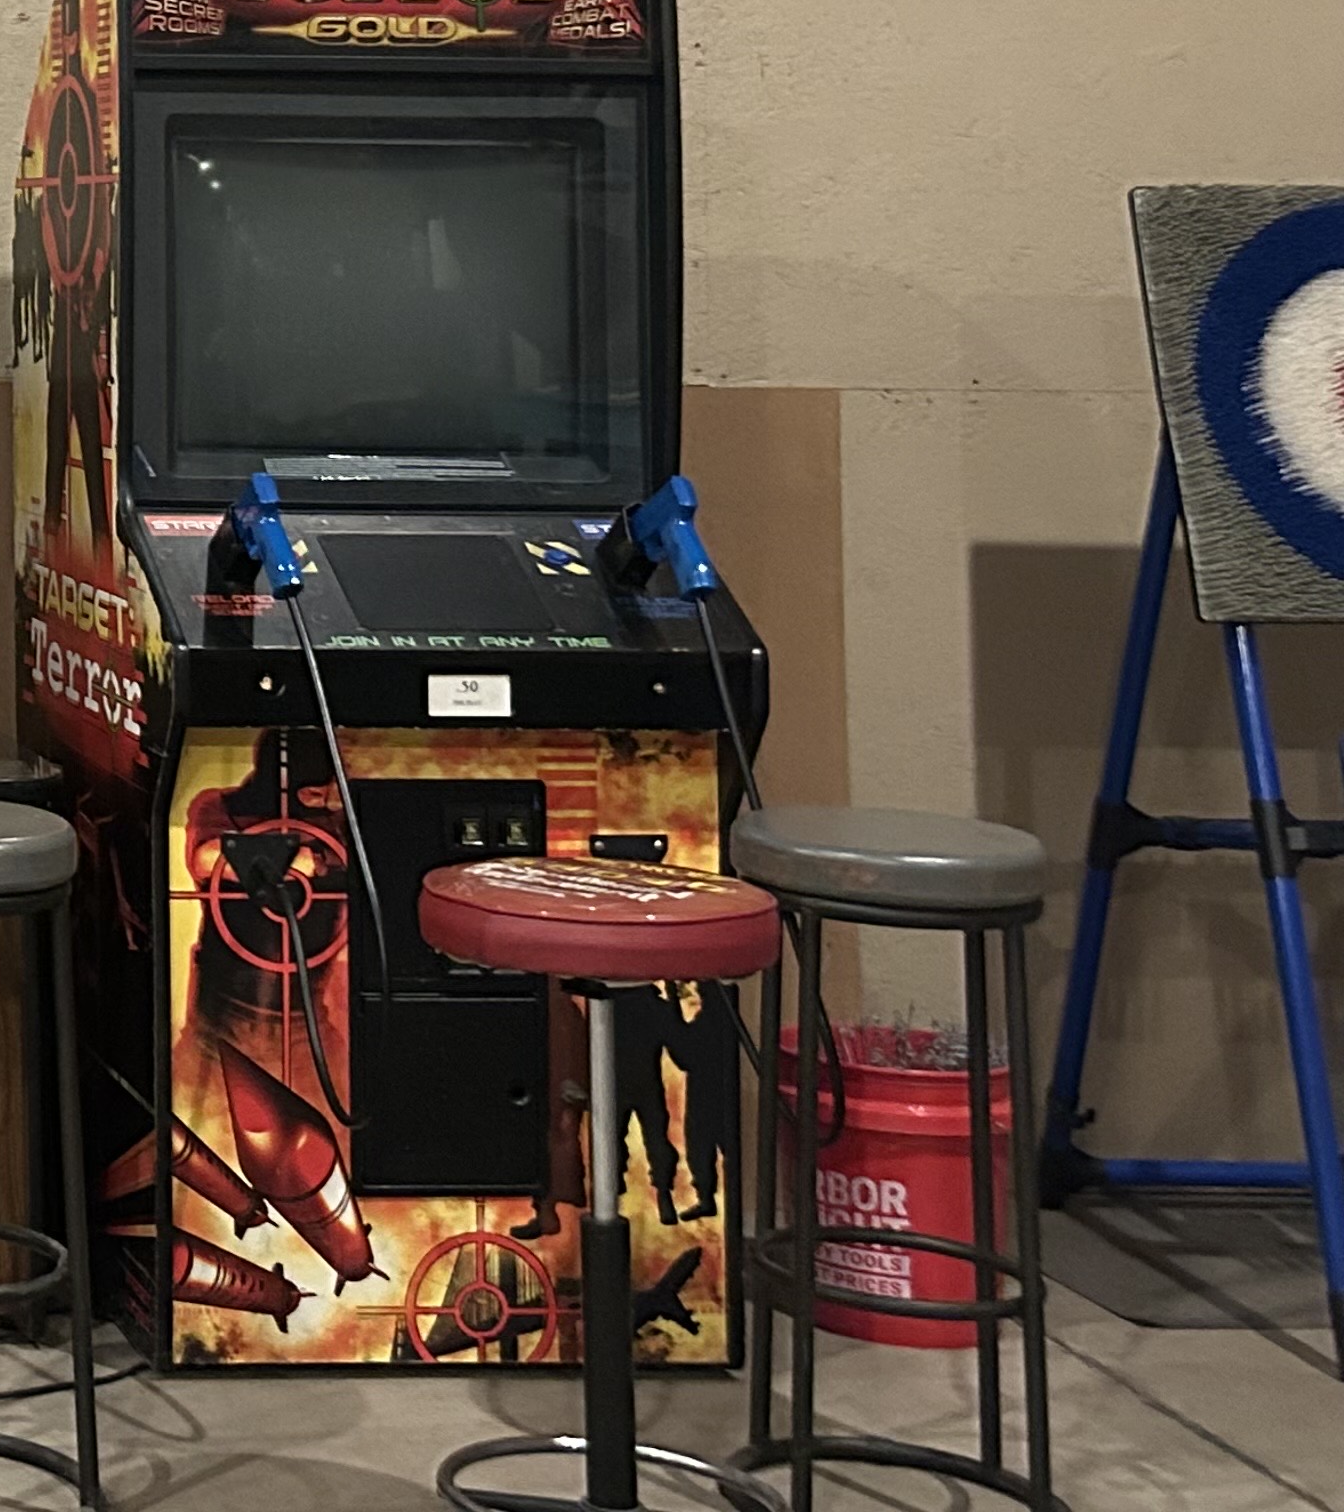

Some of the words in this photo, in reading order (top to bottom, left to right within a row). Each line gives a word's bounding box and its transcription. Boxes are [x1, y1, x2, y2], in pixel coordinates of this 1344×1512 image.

[552, 3, 631, 27] COMBAT
[312, 16, 457, 40] GOLD
[33, 563, 137, 649] TARGET:
[324, 636, 381, 648] JOIN
[391, 636, 417, 647] IN
[427, 636, 466, 647] AT
[478, 636, 535, 648] ANY
[547, 636, 612, 649] TIME
[31, 617, 142, 737] Terror
[815, 1168, 910, 1218] BOR
[840, 1249, 902, 1272] TOOLS
[831, 1269, 902, 1295] PRICES
